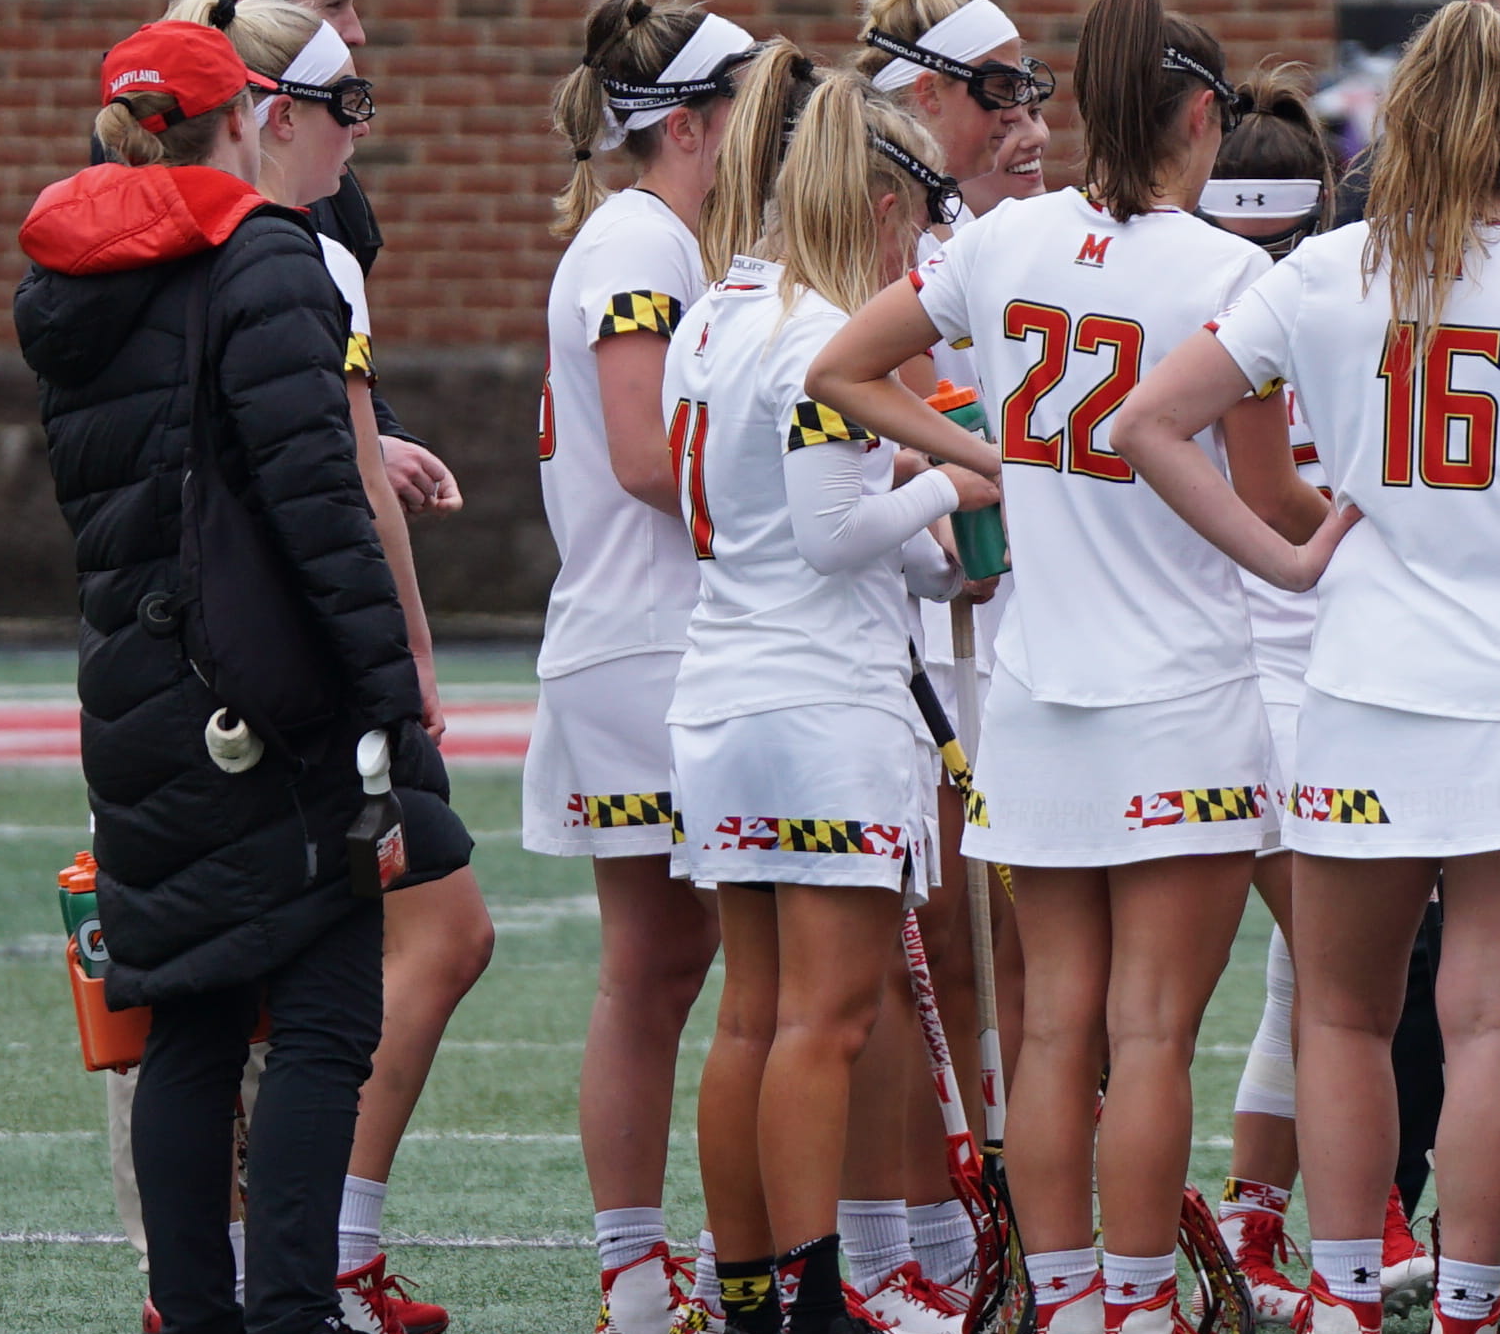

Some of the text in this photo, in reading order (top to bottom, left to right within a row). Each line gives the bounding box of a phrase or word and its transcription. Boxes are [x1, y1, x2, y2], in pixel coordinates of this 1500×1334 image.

[1176, 53, 1216, 81] UNDER
[110, 69, 162, 93] MARYLAND
[290, 86, 333, 100] UNDER
[629, 86, 675, 95] UNDER
[1075, 233, 1115, 265] M
[1002, 299, 1143, 483] 22
